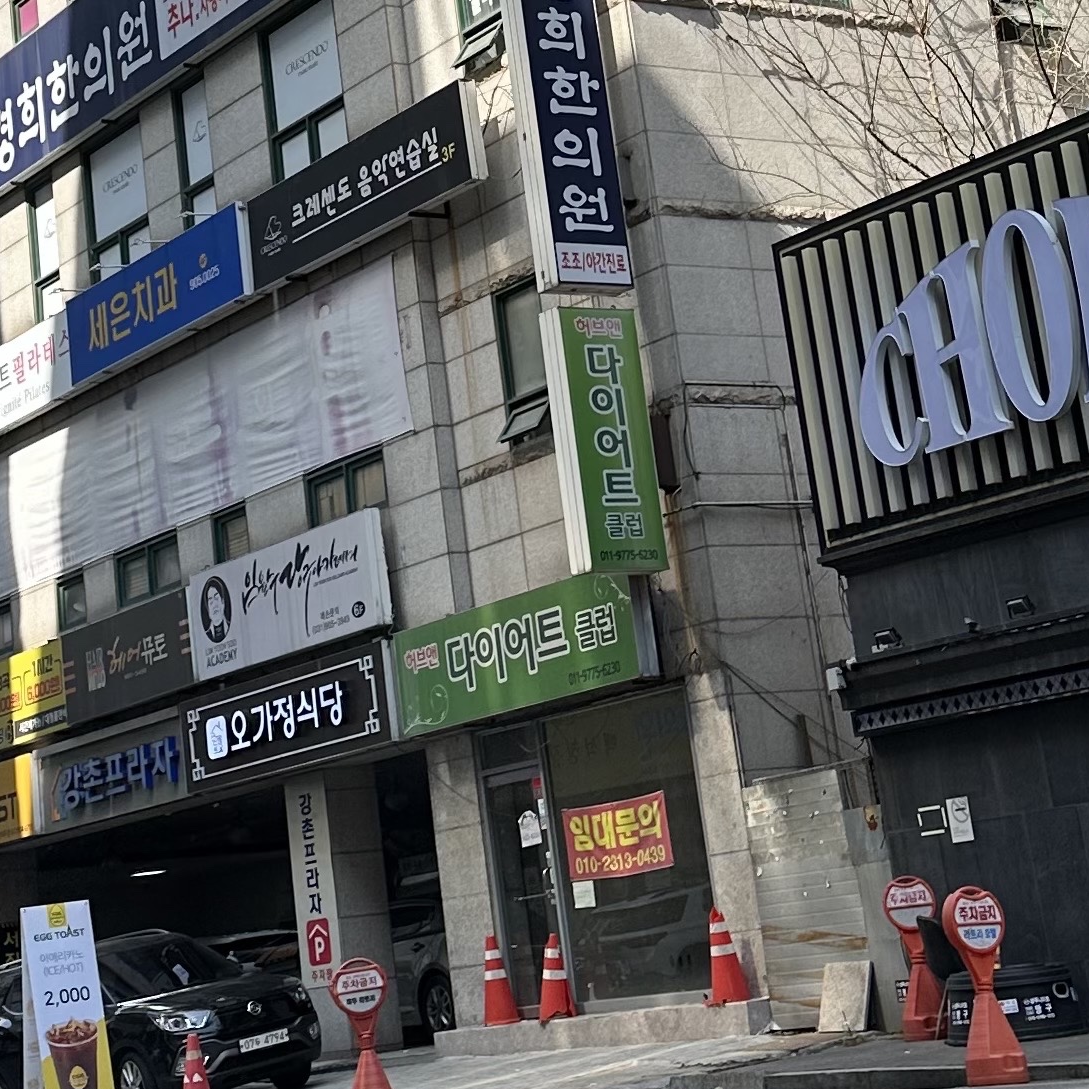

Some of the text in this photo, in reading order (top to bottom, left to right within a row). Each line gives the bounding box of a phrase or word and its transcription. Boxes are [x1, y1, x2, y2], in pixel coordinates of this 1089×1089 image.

[291, 127, 456, 227] 크레센도 음악연습실 3F
[89, 262, 178, 351] 세은치과
[575, 316, 624, 339] 허브앤
[24, 380, 51, 404] Pilates
[584, 344, 641, 506] 다이어트
[605, 513, 645, 539] 클럽
[207, 647, 238, 668] ACADEMY
[445, 605, 571, 693] 다이어트
[574, 602, 618, 652] 클럽
[231, 680, 343, 751] 오가정식당
[569, 801, 663, 852] 임대문의
[575, 844, 666, 875] 010-2313-0439
[34, 924, 85, 942] EGG TOAST
[43, 986, 91, 1008] 2,000
